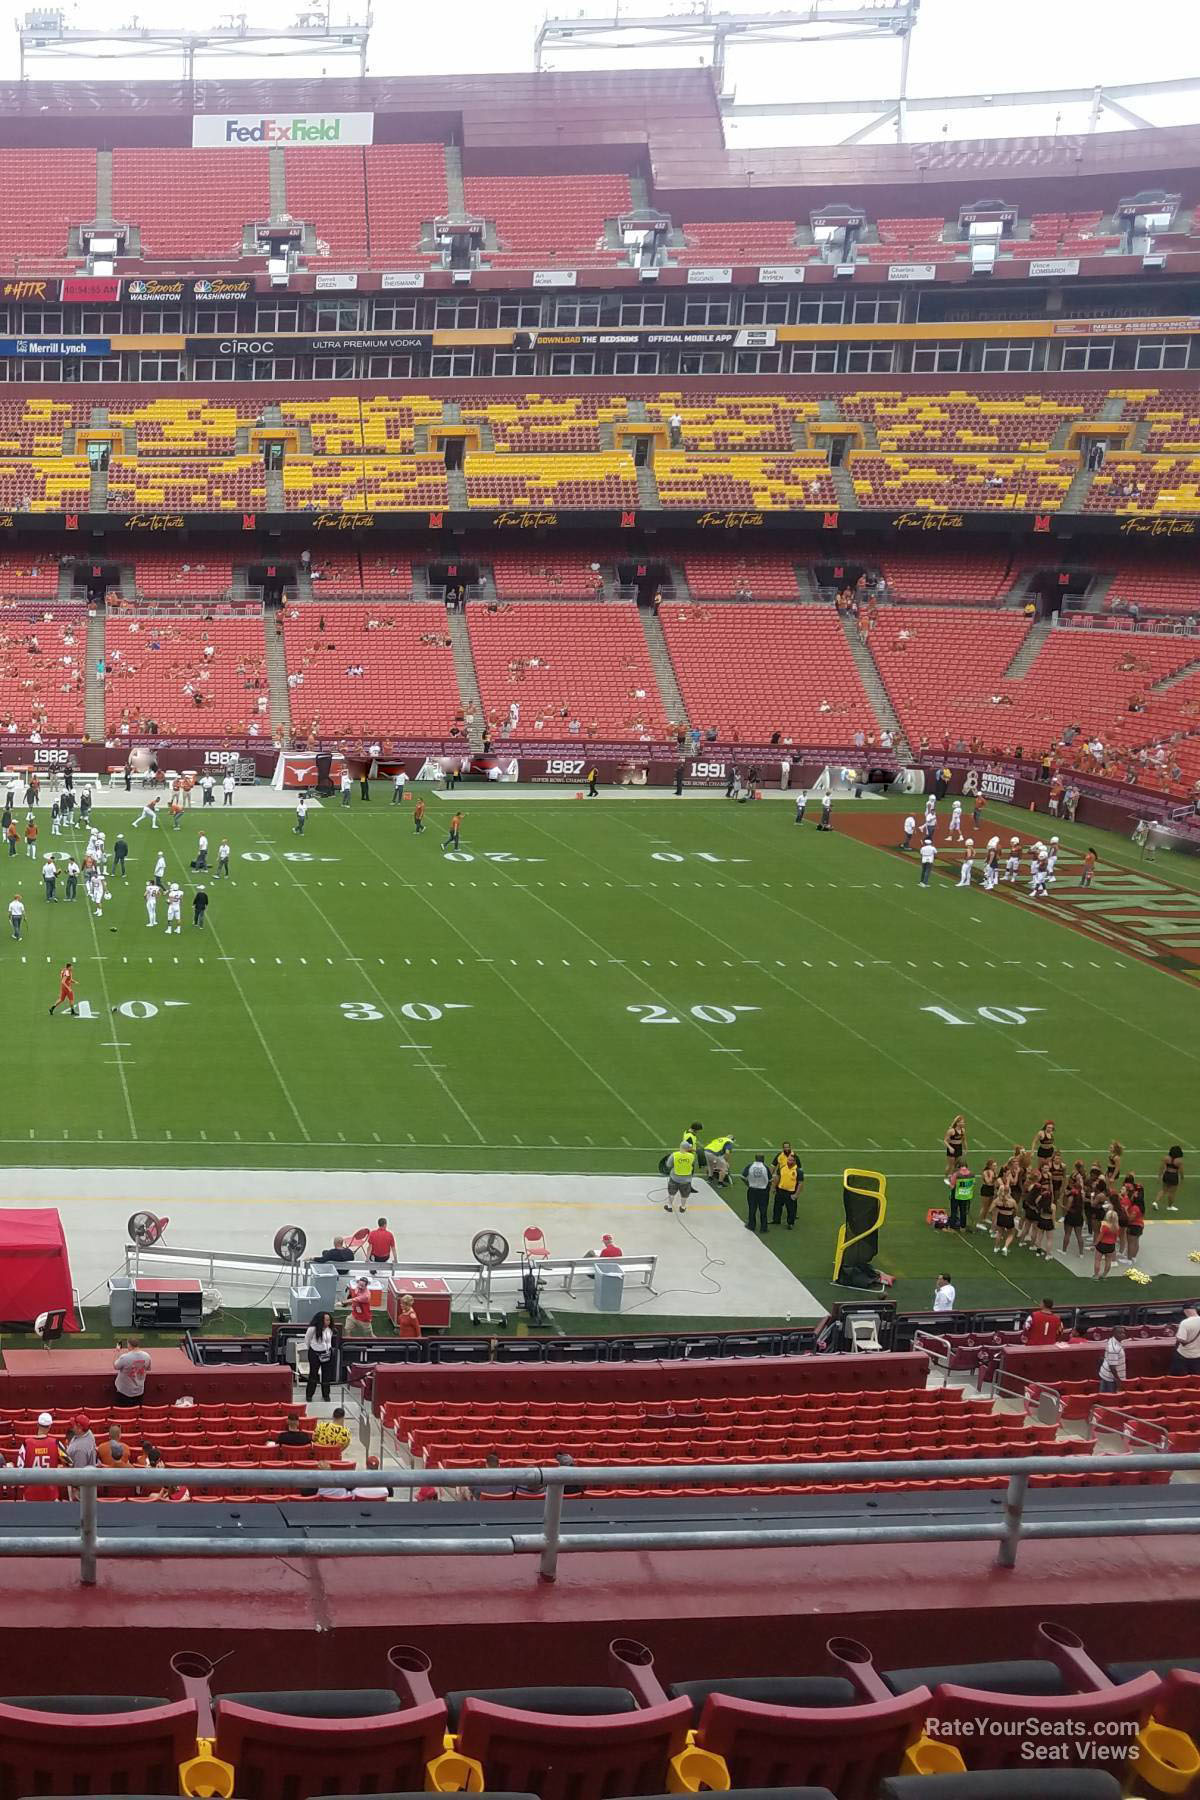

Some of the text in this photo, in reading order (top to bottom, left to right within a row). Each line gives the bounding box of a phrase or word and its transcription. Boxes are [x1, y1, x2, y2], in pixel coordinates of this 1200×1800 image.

[226, 119, 341, 142] FedExField
[145, 280, 185, 295] Sports
[210, 280, 250, 294] Sports
[130, 293, 181, 301] WASHINGTON
[195, 292, 246, 300] WASHINGTON
[313, 339, 422, 349] ULTRA PREMIUM VODKA
[537, 336, 581, 345] DOWNLOAD
[582, 335, 597, 343] THE
[599, 335, 639, 343] REDSKINS
[648, 335, 683, 343] OFFICIAL
[715, 334, 732, 342] APP
[29, 343, 87, 354] Merrill Lynch
[33, 749, 69, 763] 1982
[545, 760, 584, 774] 1987
[690, 763, 726, 777] 1991
[981, 781, 1015, 798] SALUTE
[1043, 1321, 1050, 1336] 1
[32, 1455, 50, 1468] 45
